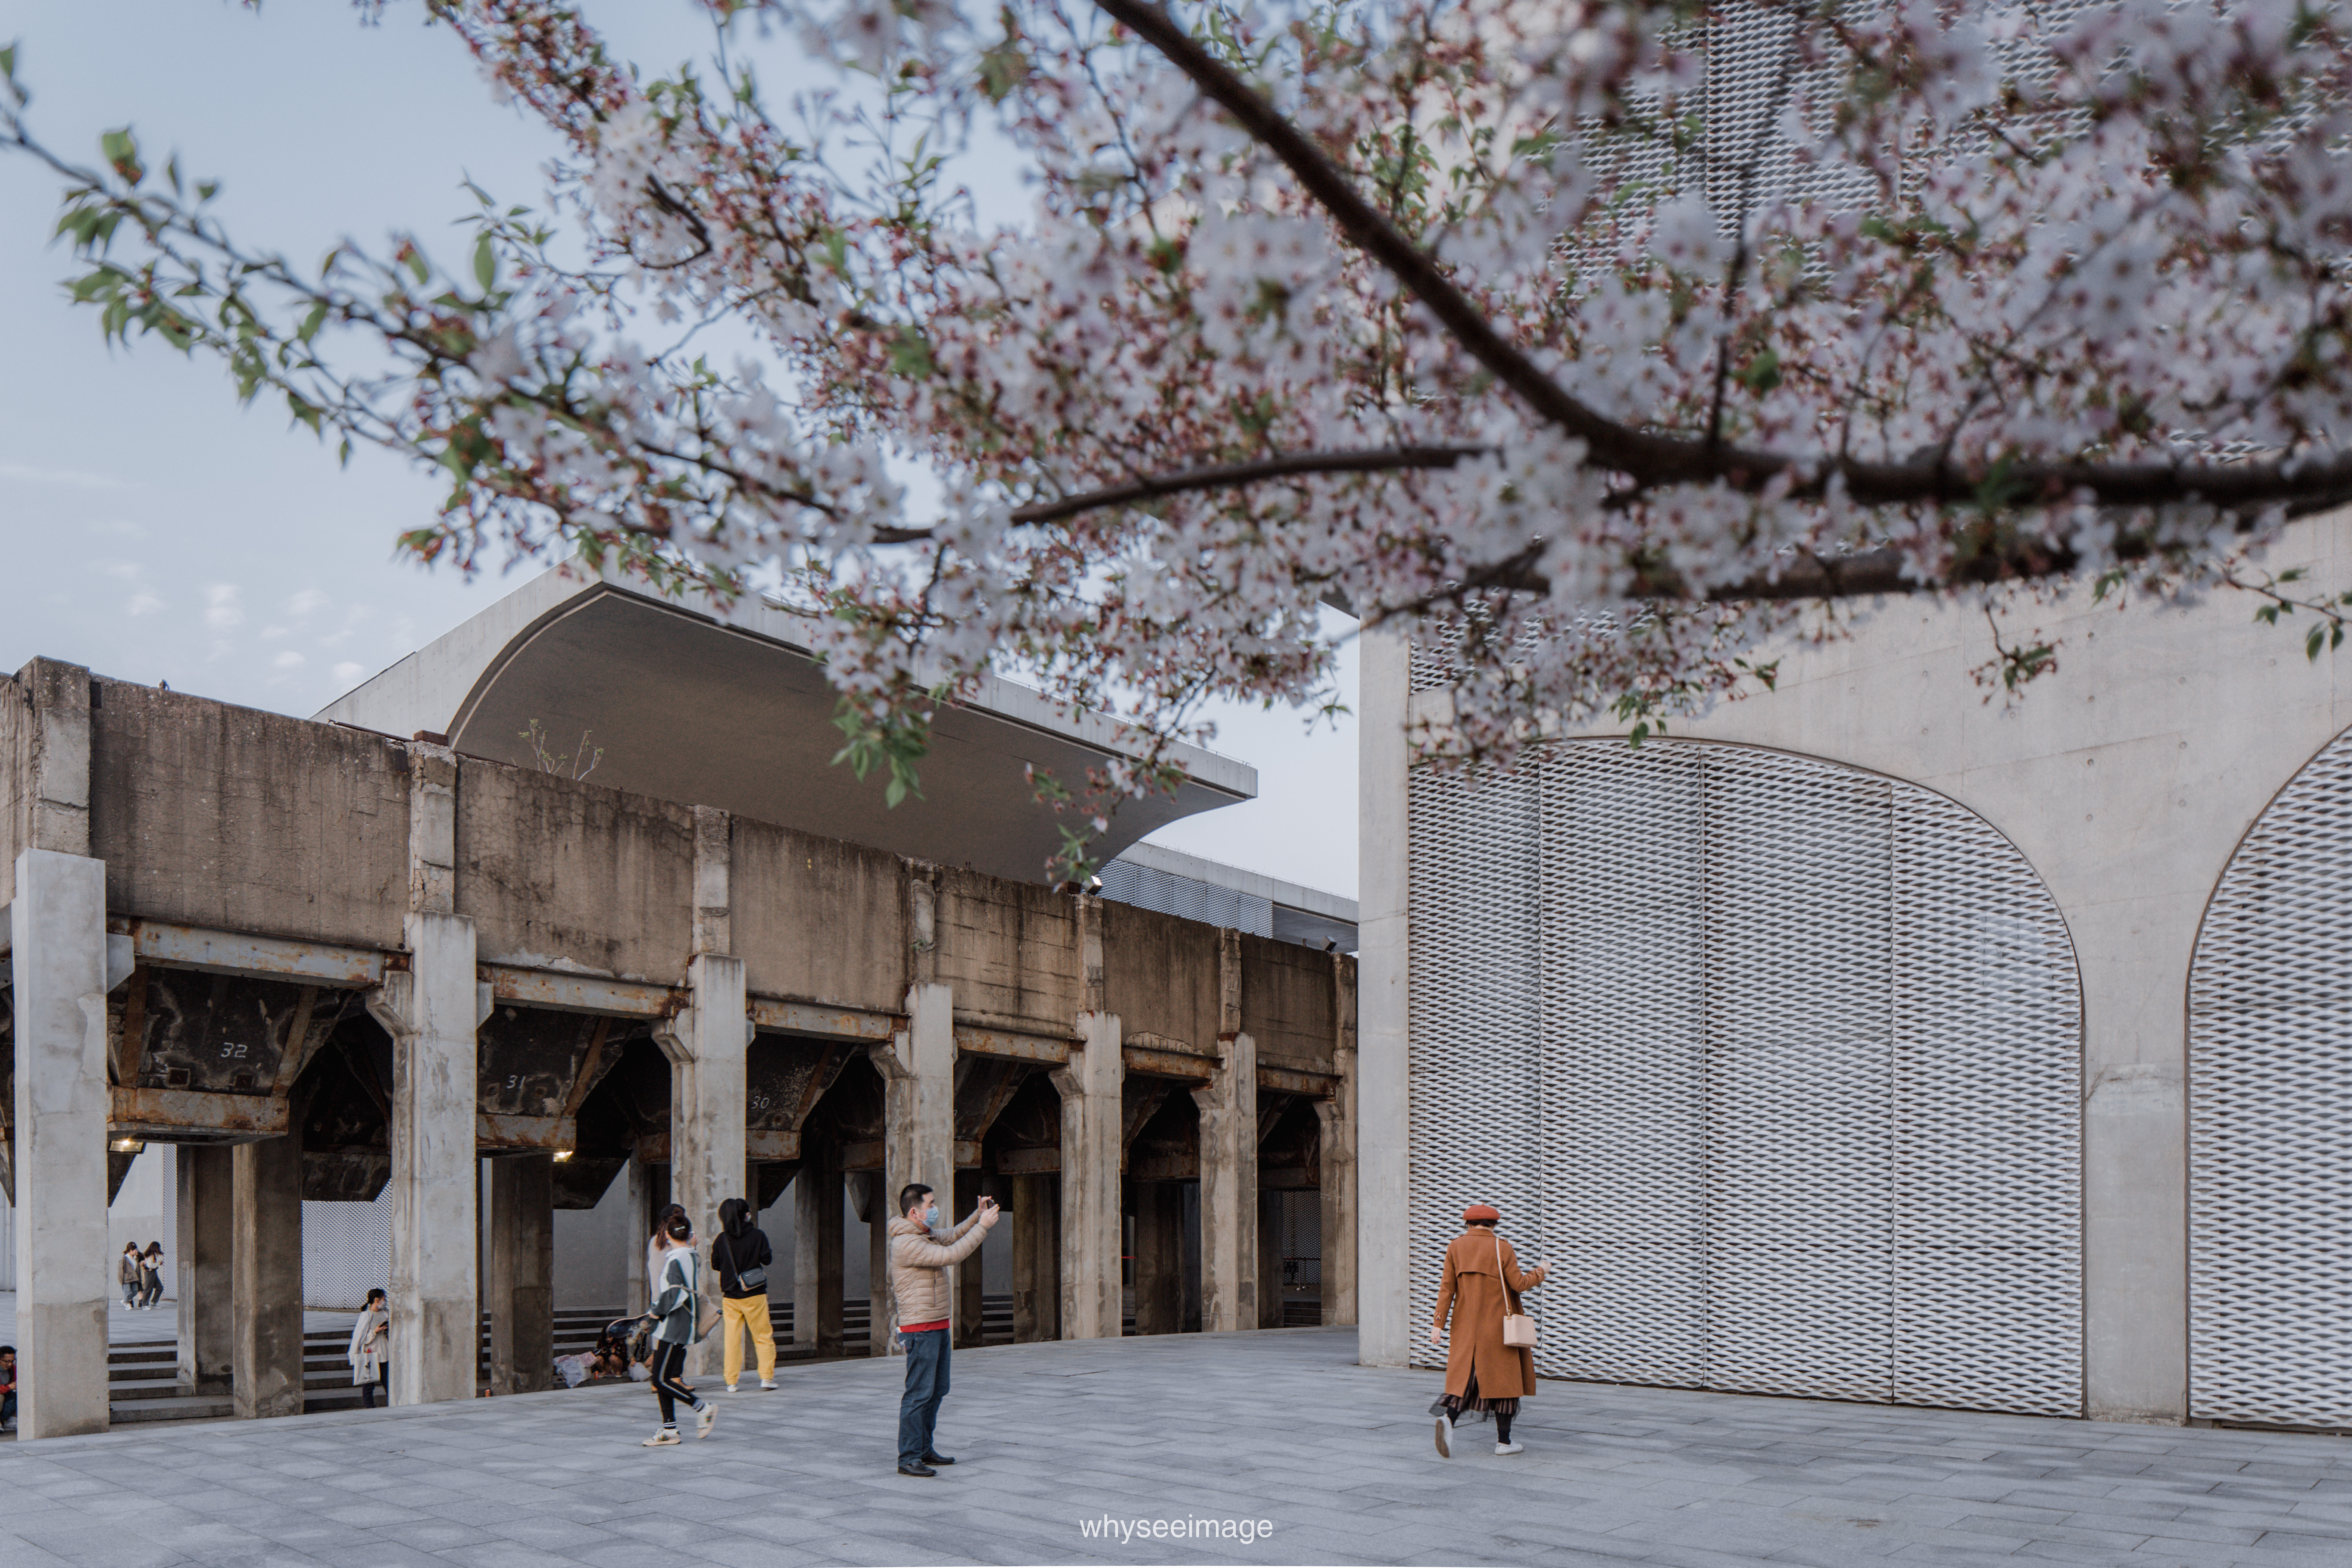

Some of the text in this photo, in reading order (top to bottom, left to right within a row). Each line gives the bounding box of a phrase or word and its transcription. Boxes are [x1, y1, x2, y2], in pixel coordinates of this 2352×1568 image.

[220, 1042, 248, 1058] 32
[506, 1075, 526, 1089] 31
[751, 1096, 770, 1109] 30
